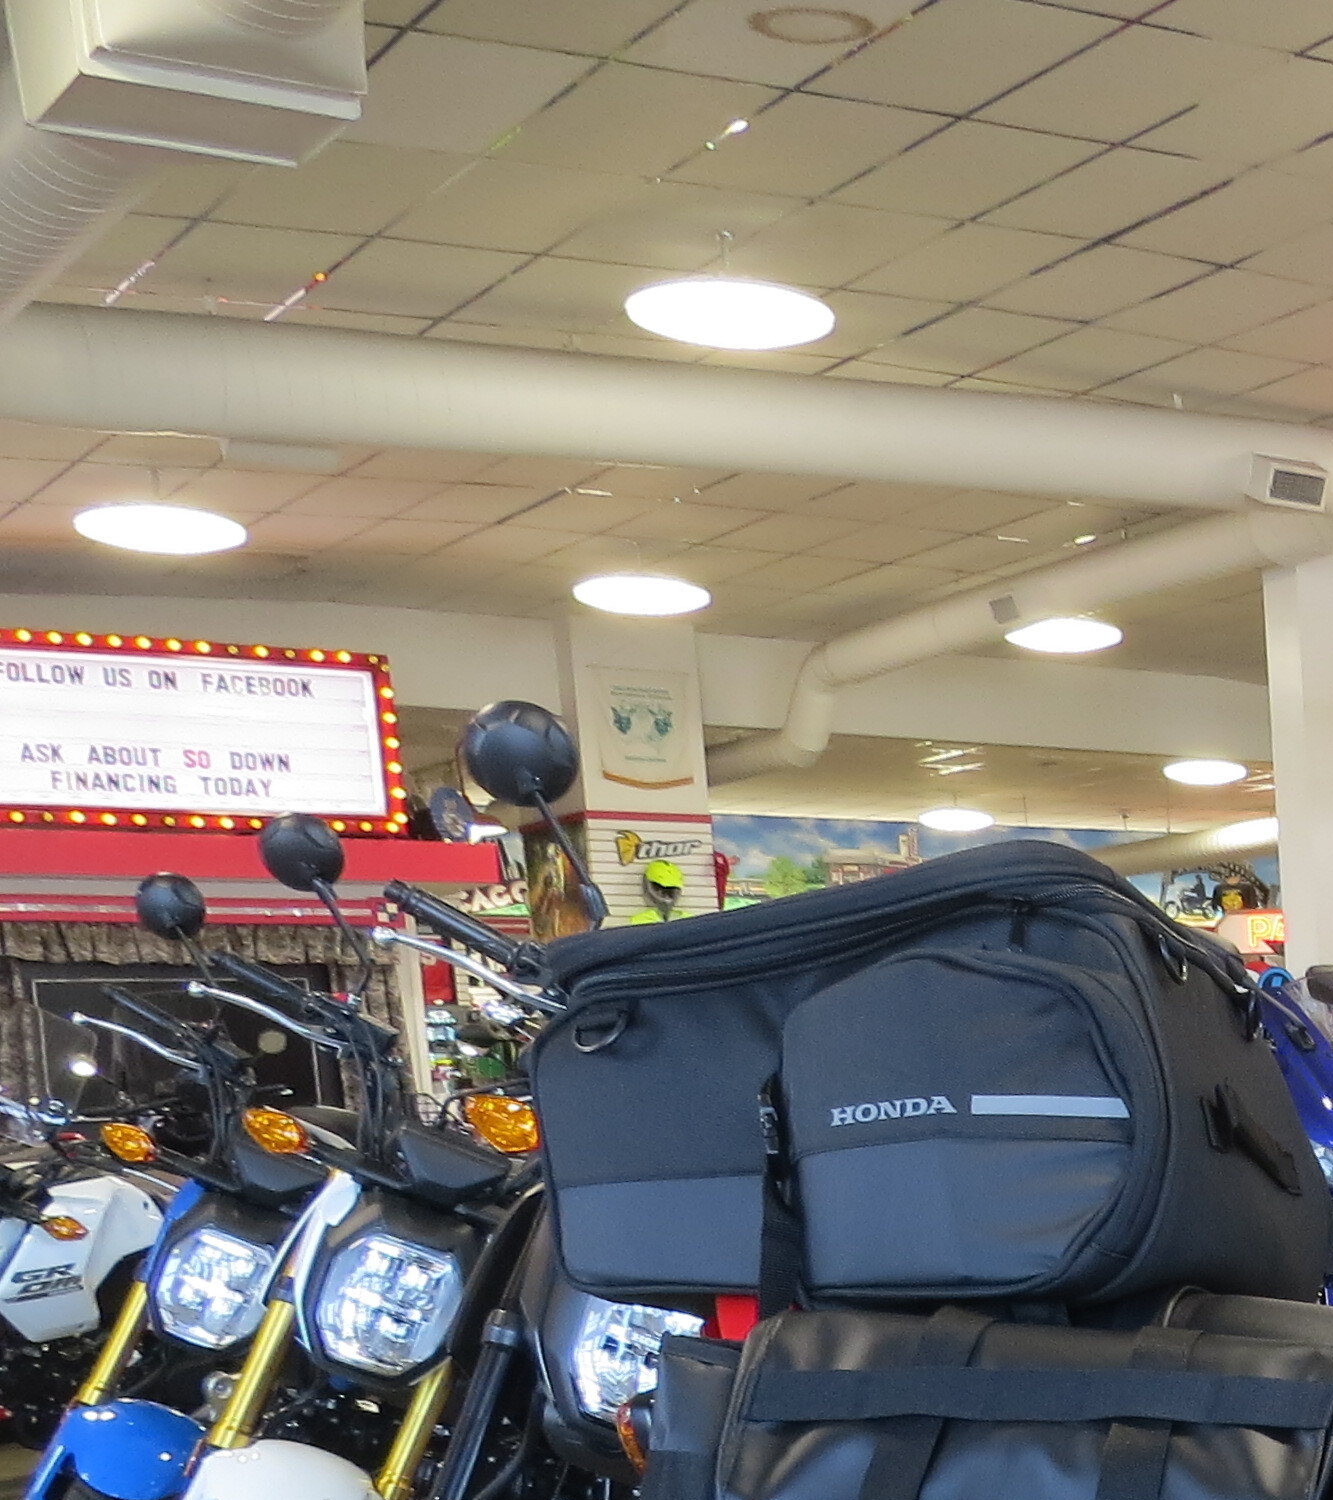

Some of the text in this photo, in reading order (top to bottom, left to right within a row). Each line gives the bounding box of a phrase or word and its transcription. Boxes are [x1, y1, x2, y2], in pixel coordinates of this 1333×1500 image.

[103, 668, 133, 688] US
[148, 670, 179, 692] ON
[201, 673, 316, 699] FACEBOOK
[20, 743, 65, 765] ASK
[87, 746, 163, 769] ABOUT
[231, 751, 292, 774] DOWN
[51, 771, 273, 798] FINANCING TODAY
[830, 1096, 958, 1127] HONDA
